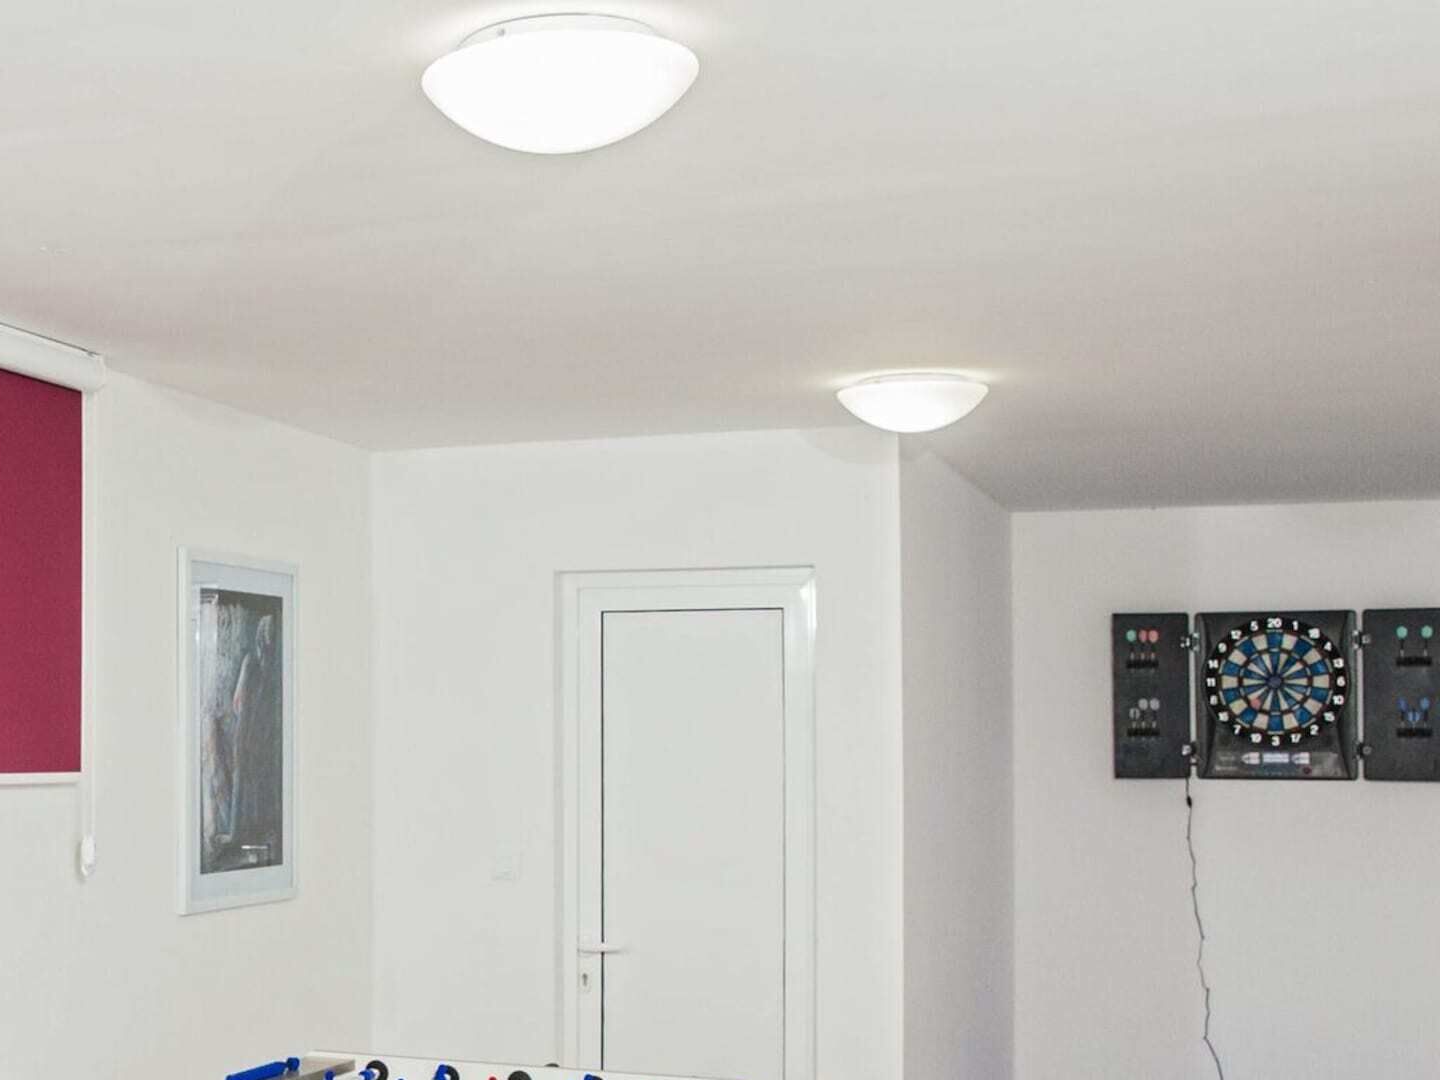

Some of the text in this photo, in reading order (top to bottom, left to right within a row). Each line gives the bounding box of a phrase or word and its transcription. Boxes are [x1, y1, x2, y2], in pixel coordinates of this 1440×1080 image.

[1250, 620, 1258, 631] 5
[1267, 617, 1282, 629] 20
[1292, 621, 1299, 631] 1
[1324, 641, 1332, 651] 4
[1233, 724, 1241, 735] 7
[1310, 724, 1319, 736] 2
[1271, 735, 1281, 747] 3
[1290, 733, 1301, 743] 17
